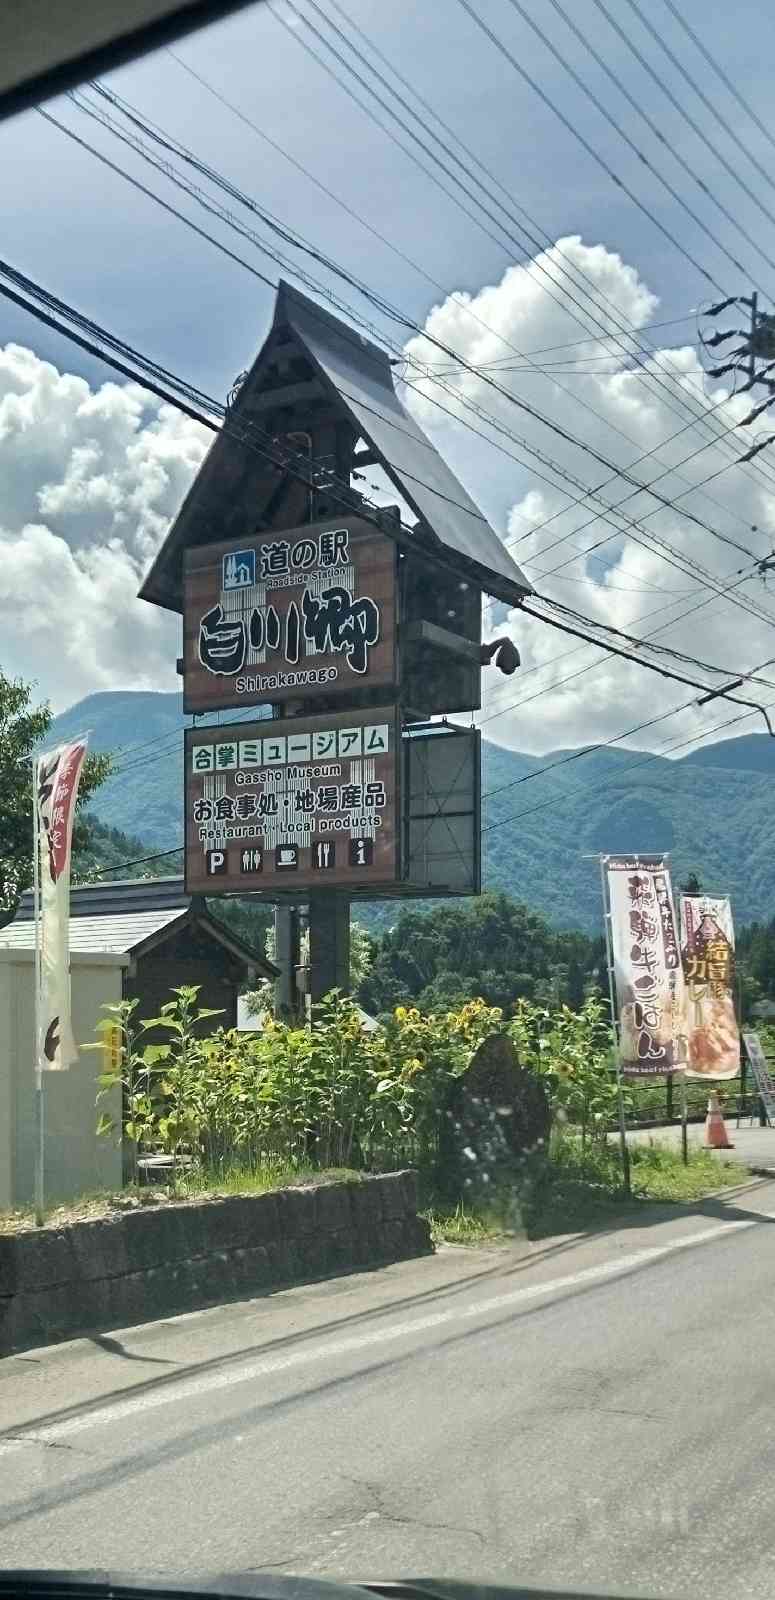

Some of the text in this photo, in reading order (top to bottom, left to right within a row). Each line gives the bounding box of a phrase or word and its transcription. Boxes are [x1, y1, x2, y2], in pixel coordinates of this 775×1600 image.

[260, 529, 349, 578] 道の駅
[266, 567, 346, 590] Roadside Station
[198, 587, 379, 675] 白川郷
[235, 667, 338, 694] Shirakawago
[193, 727, 386, 770] 合掌ミュージアム
[235, 764, 342, 786] Gassho Museum
[193, 781, 386, 823] お食事処・地場産品
[318, 813, 382, 833] products
